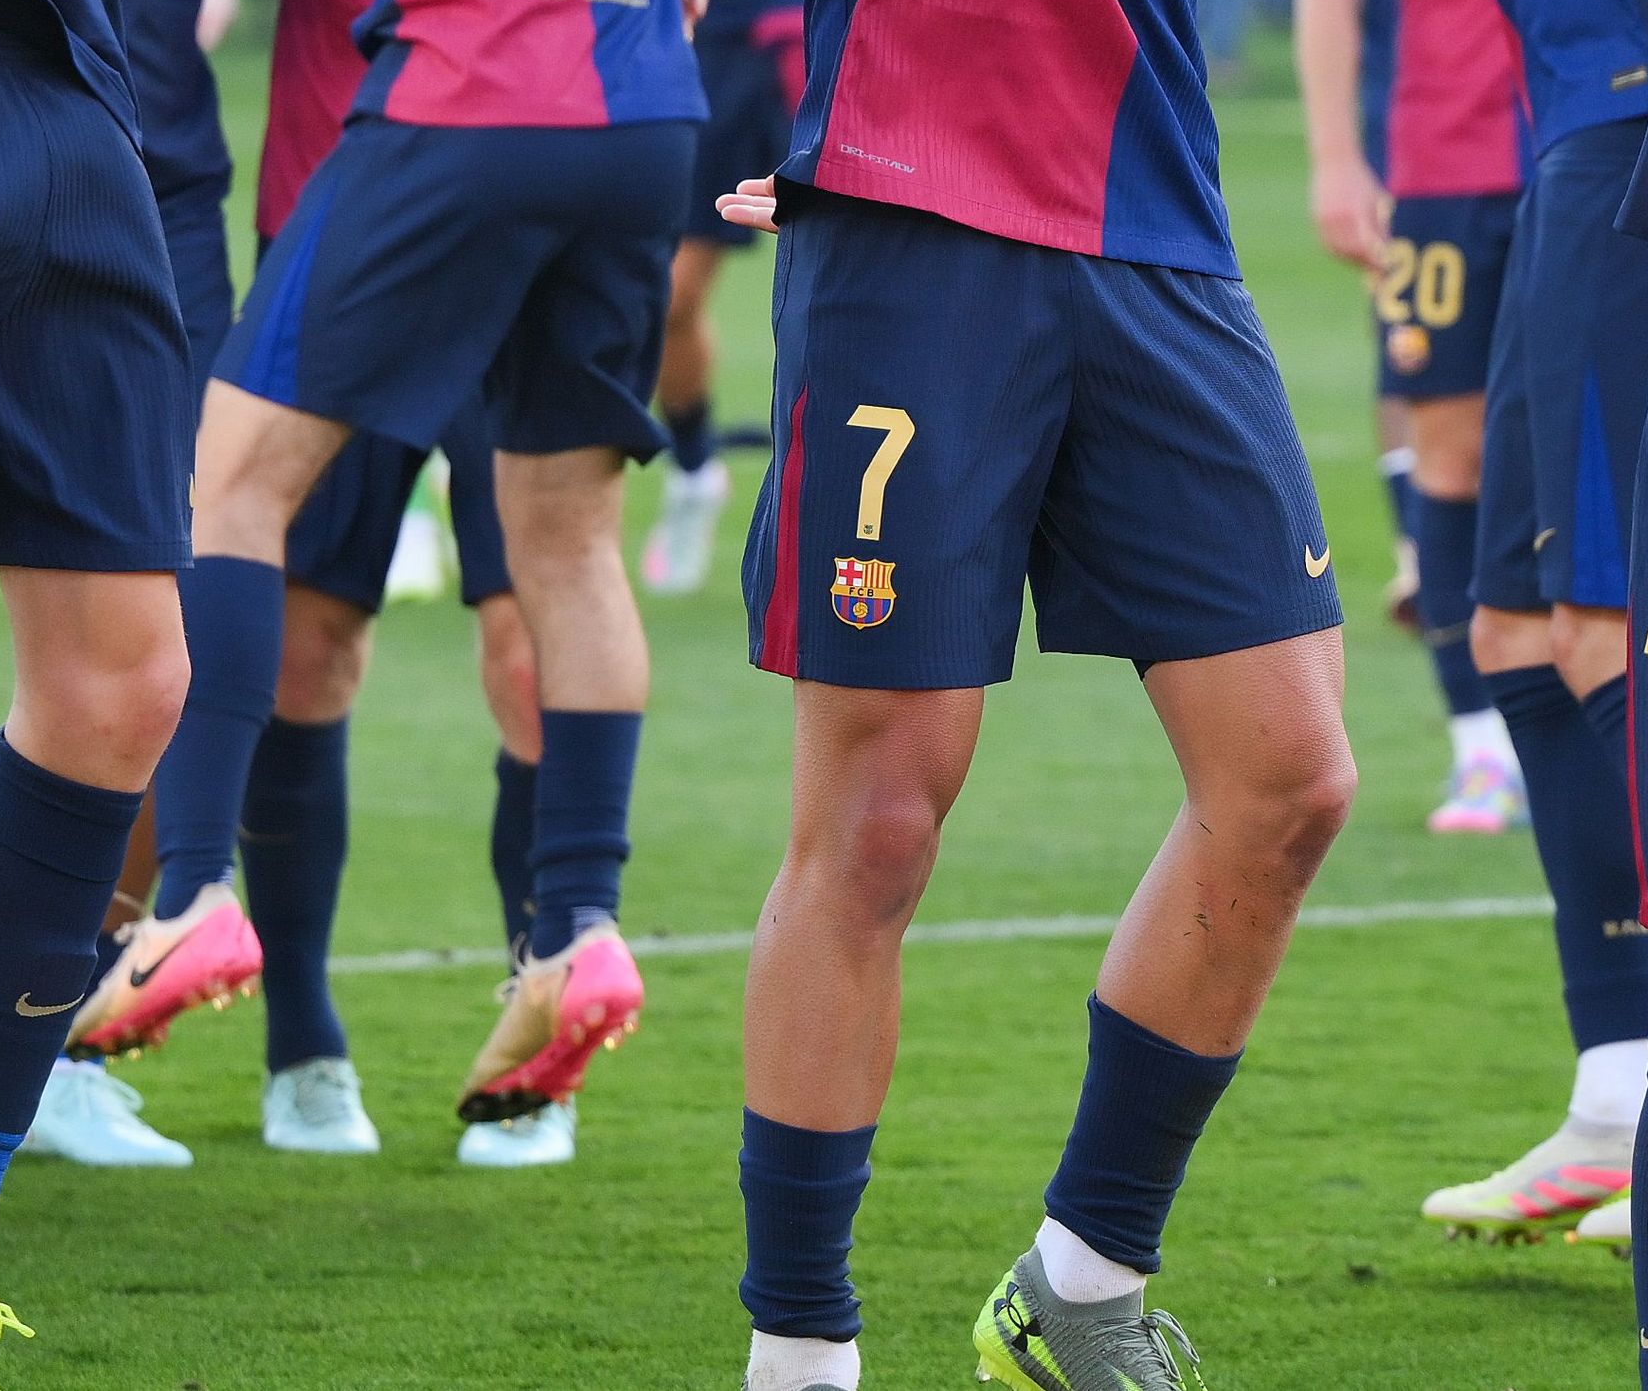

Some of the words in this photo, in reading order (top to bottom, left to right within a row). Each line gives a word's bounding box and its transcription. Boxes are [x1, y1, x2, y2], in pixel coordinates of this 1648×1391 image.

[1374, 236, 1466, 328] 20
[846, 404, 916, 542] 7
[848, 586, 875, 598] FCB
